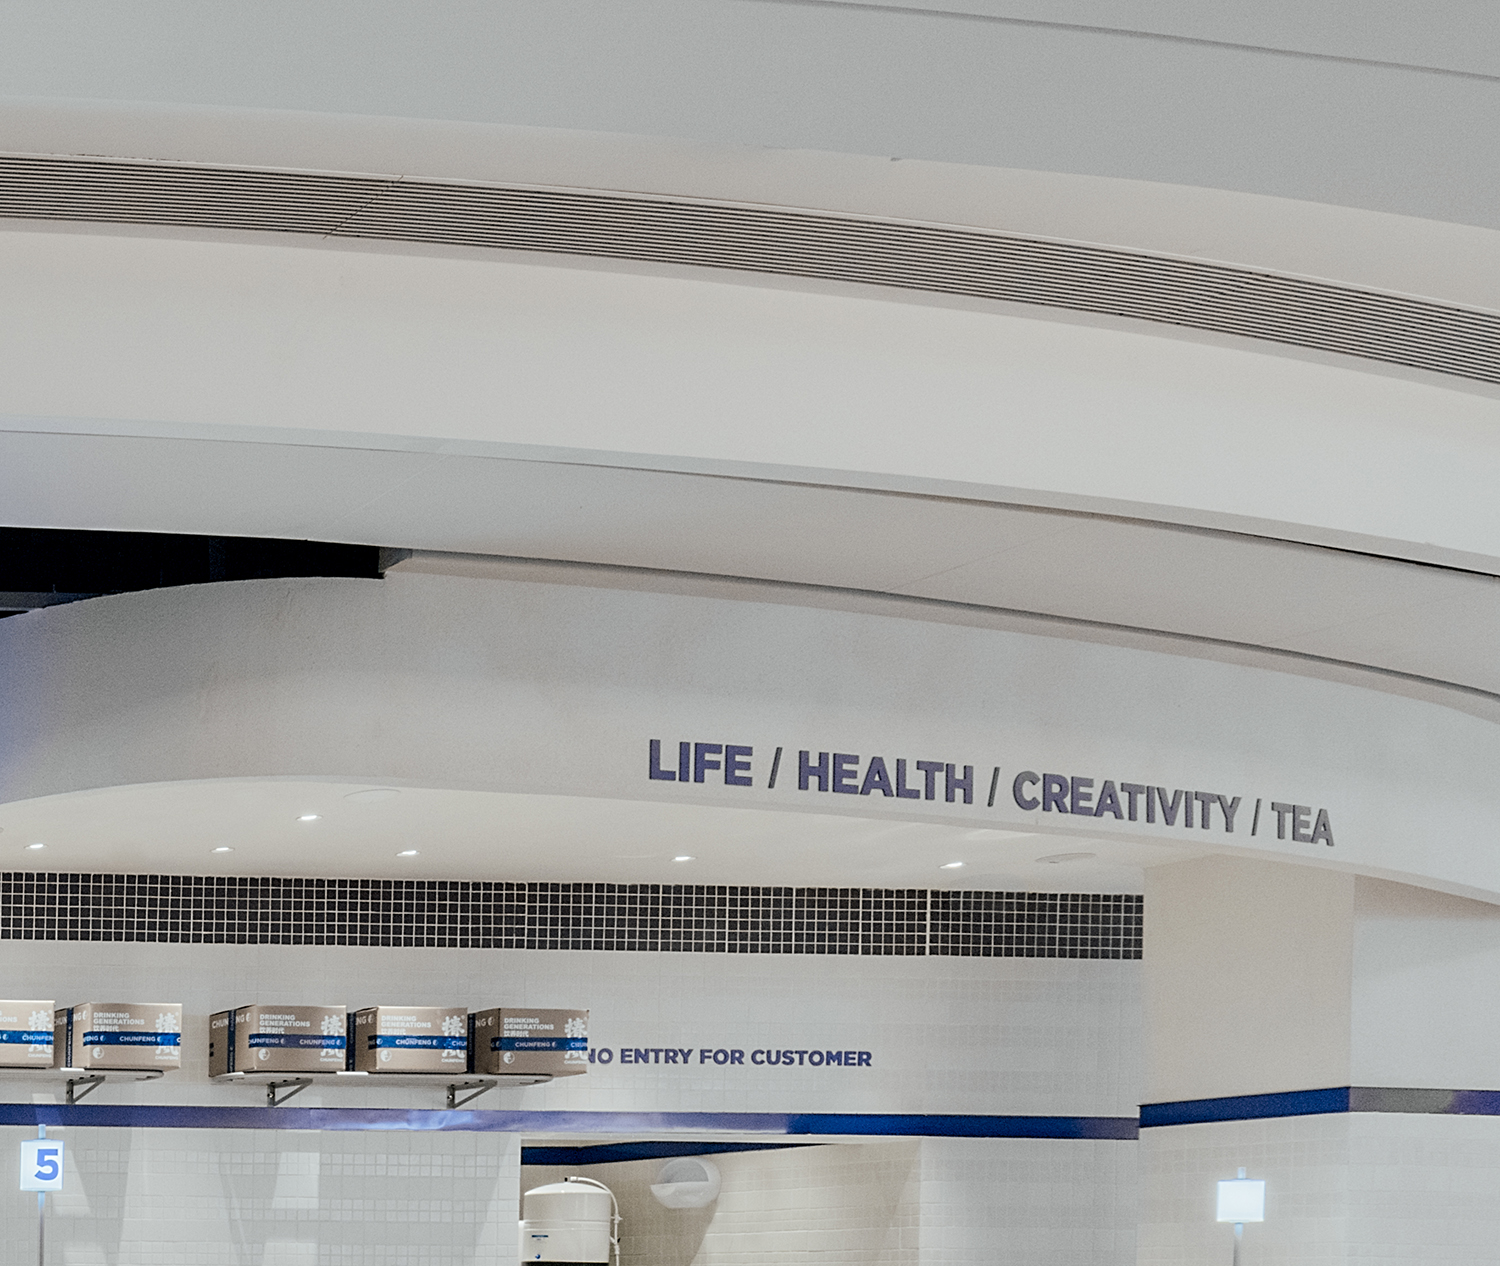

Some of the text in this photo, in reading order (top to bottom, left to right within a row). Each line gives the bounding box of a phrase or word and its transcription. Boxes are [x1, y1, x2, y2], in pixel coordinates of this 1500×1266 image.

[648, 738, 1335, 847] LIFE / HEALTH / CREATIVITY / TEA
[620, 1048, 694, 1065] ENTRY
[699, 1048, 745, 1066] FOR
[750, 1049, 872, 1067] CUSTOMER
[34, 1148, 59, 1181] 5
